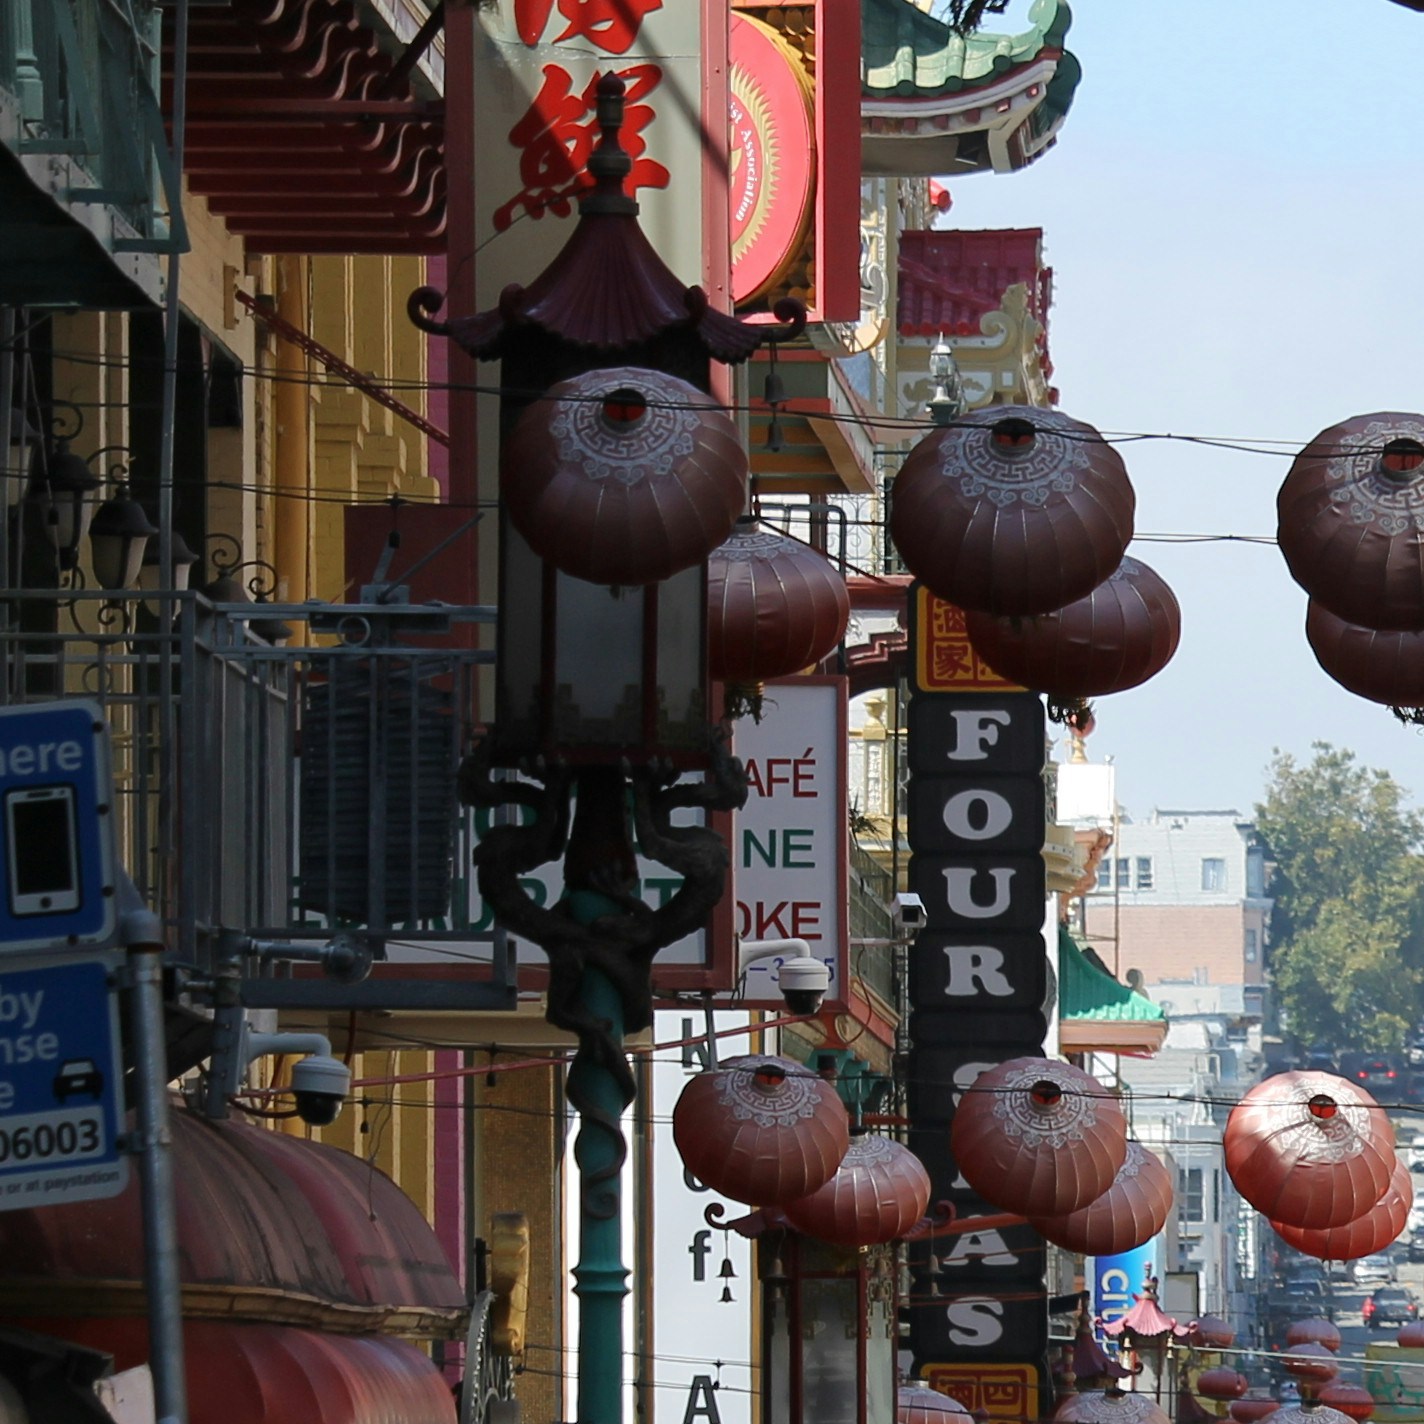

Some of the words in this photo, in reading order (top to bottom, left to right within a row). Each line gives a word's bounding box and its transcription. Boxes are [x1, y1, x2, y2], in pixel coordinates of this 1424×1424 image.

[490, 0, 667, 232] 鮮
[735, 130, 758, 222] Association
[0, 741, 82, 776] ere
[745, 747, 818, 798] AFÉ
[942, 710, 1017, 996] FOUR
